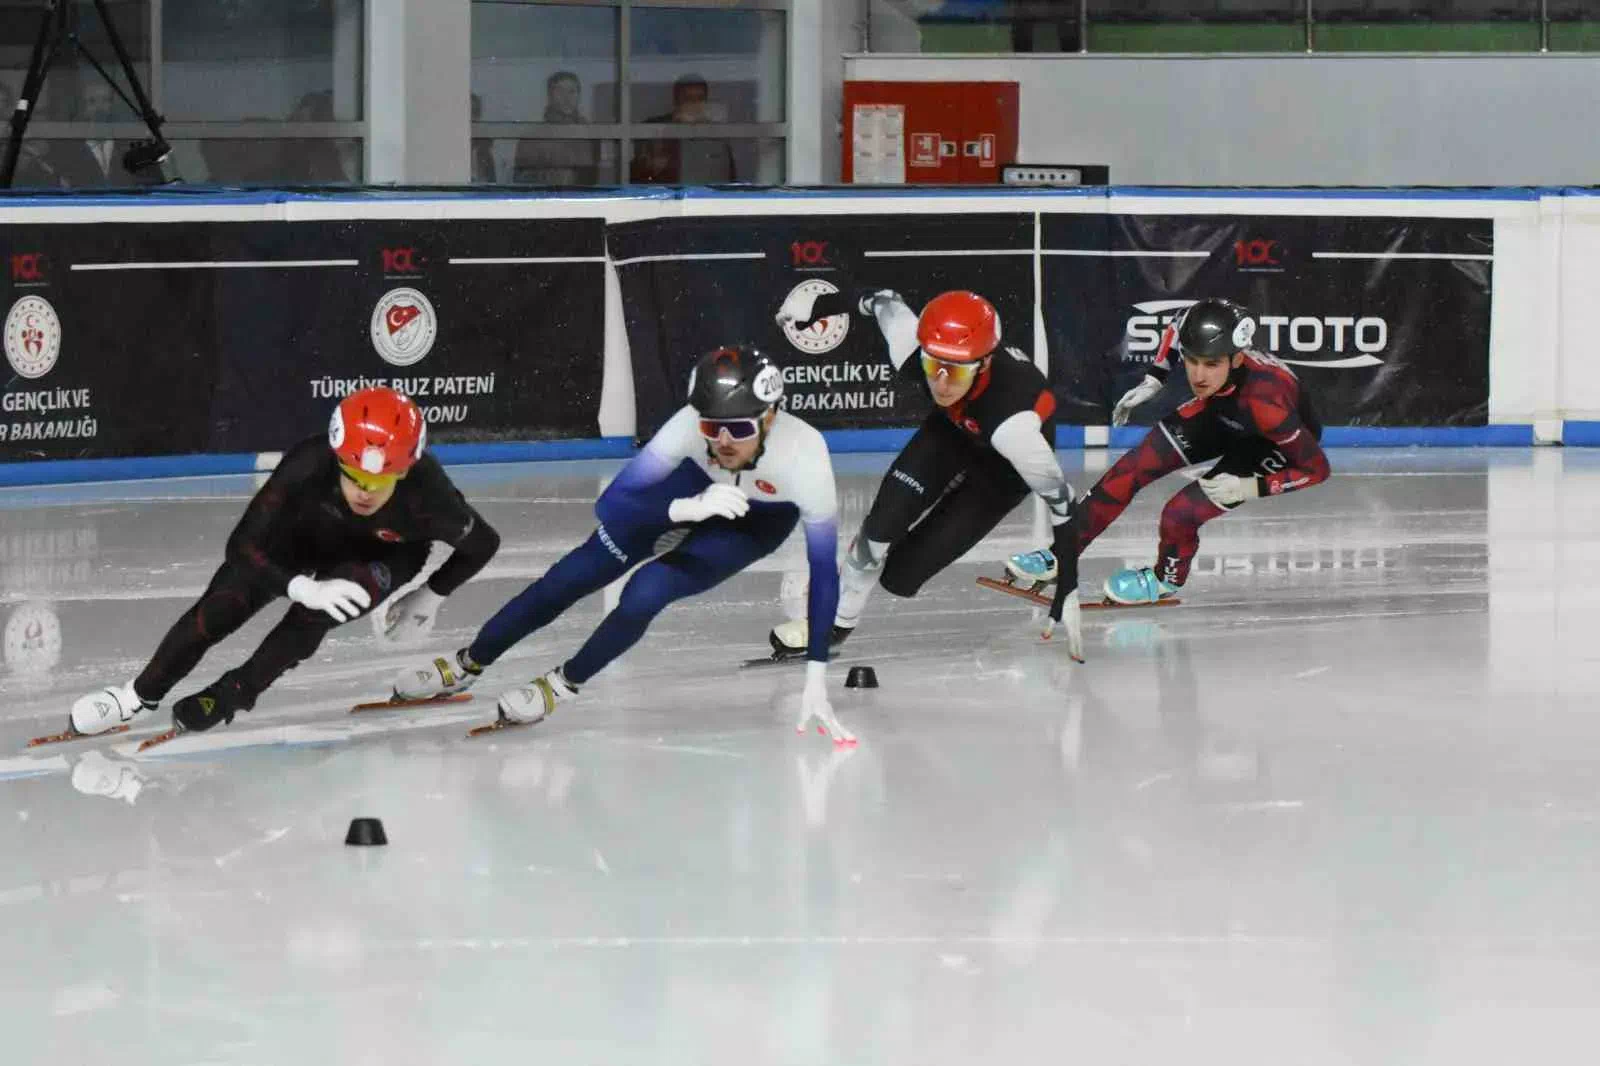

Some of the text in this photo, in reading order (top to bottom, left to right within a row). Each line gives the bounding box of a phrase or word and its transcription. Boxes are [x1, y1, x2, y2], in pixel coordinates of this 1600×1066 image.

[392, 378, 429, 396] BUZ
[434, 372, 495, 395] PATENİ
[782, 361, 891, 388] GENÇLİK VE
[2, 386, 90, 415] GENÇLİK VE
[791, 387, 895, 410] BAKANLIĞI
[10, 415, 97, 440] BAKANLIĞI
[892, 469, 924, 494] NERPA
[598, 524, 628, 563] NERPA
